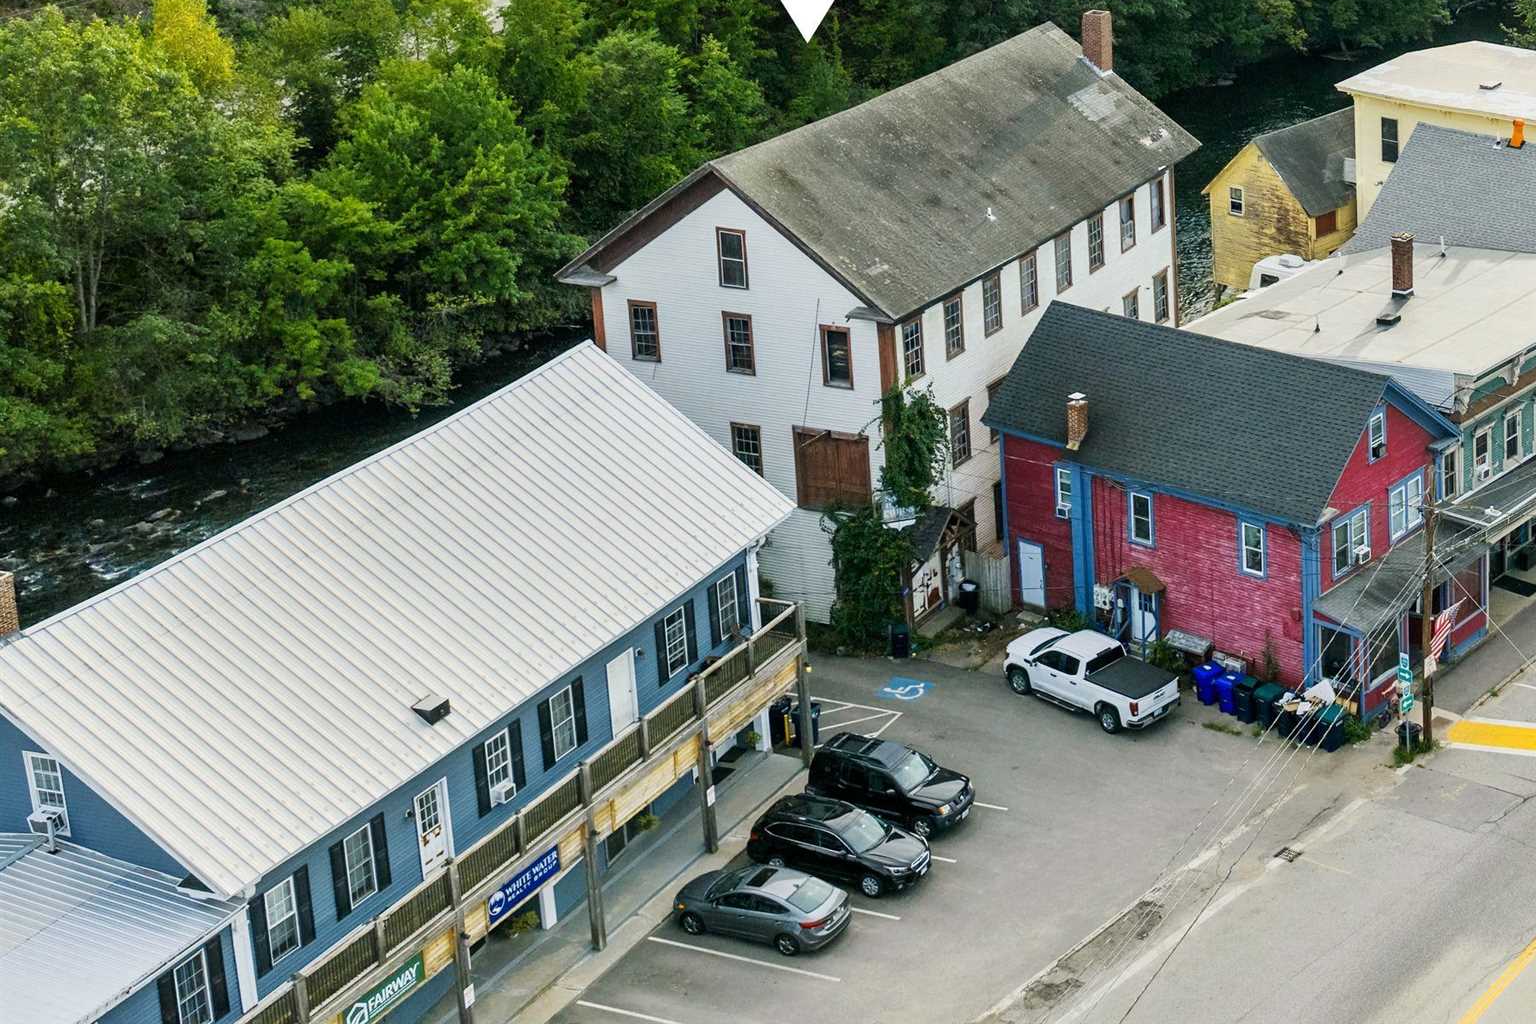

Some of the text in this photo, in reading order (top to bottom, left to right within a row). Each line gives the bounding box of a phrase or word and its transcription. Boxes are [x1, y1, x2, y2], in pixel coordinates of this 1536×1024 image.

[505, 850, 558, 896] WHITE WATER
[507, 860, 558, 903] REALTY GROUP
[367, 961, 420, 1013] FAIRWAY
